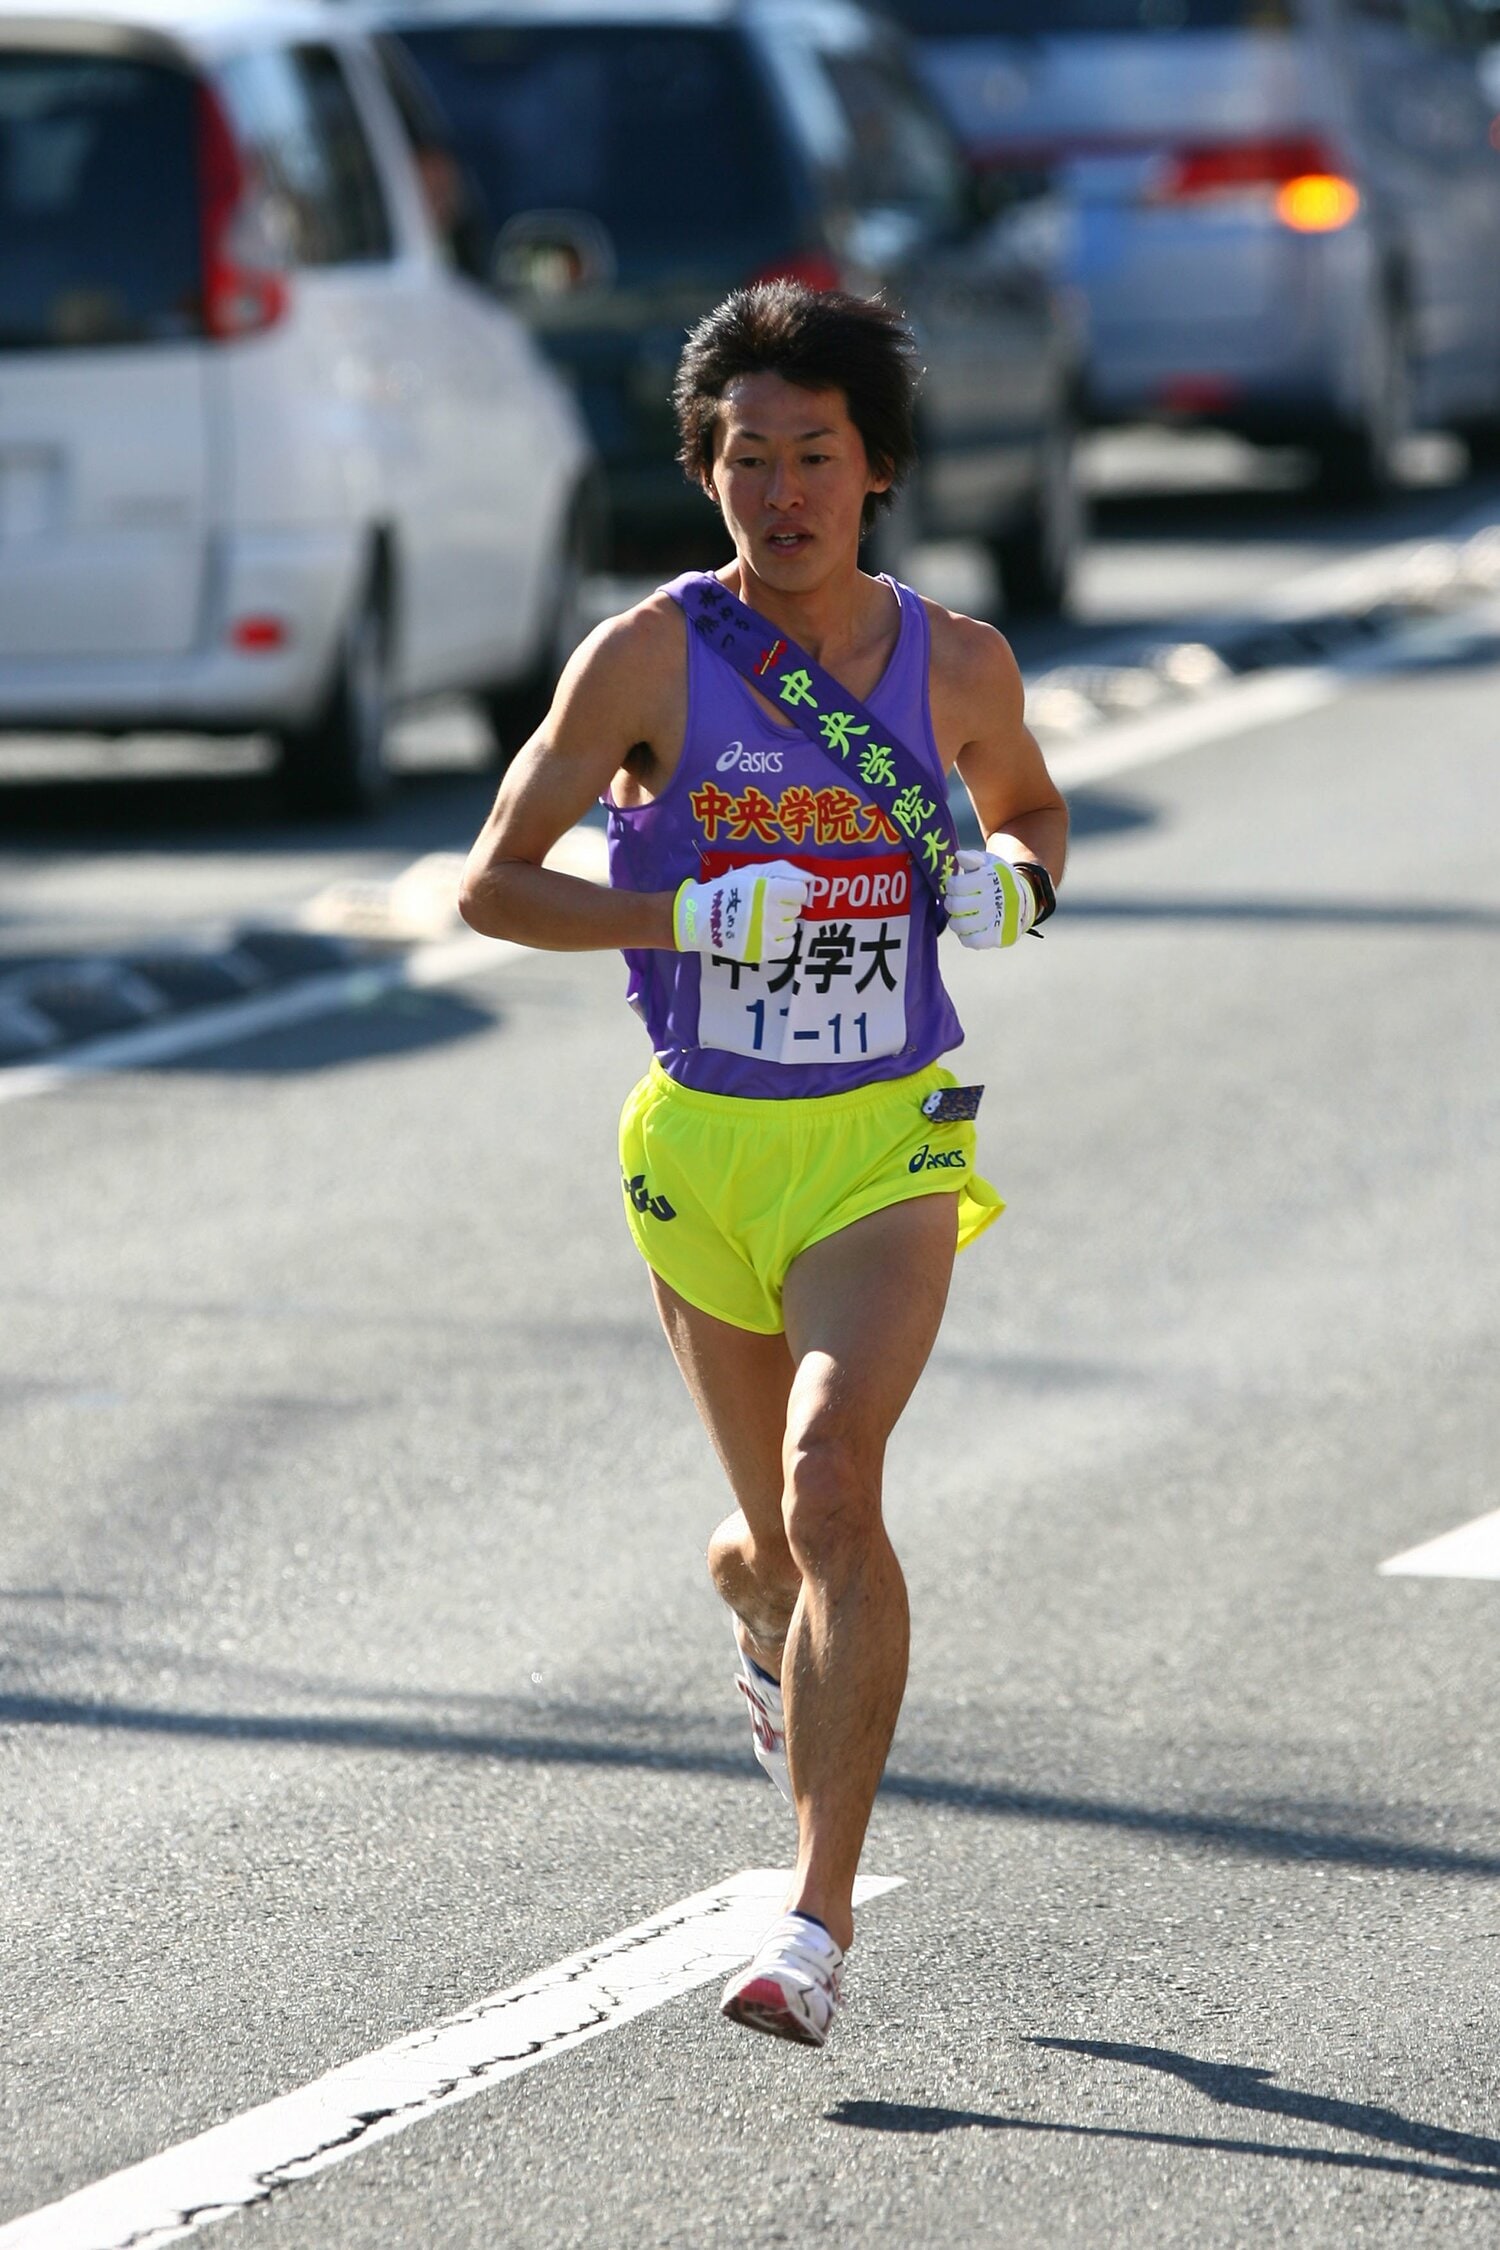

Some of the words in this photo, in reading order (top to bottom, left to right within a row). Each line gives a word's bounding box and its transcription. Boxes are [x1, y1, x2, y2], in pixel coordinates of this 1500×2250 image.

[737, 750, 784, 774] asics
[689, 781, 902, 846] 中央学院大
[803, 870, 908, 909] PPORO
[925, 1148, 967, 1171] asics
